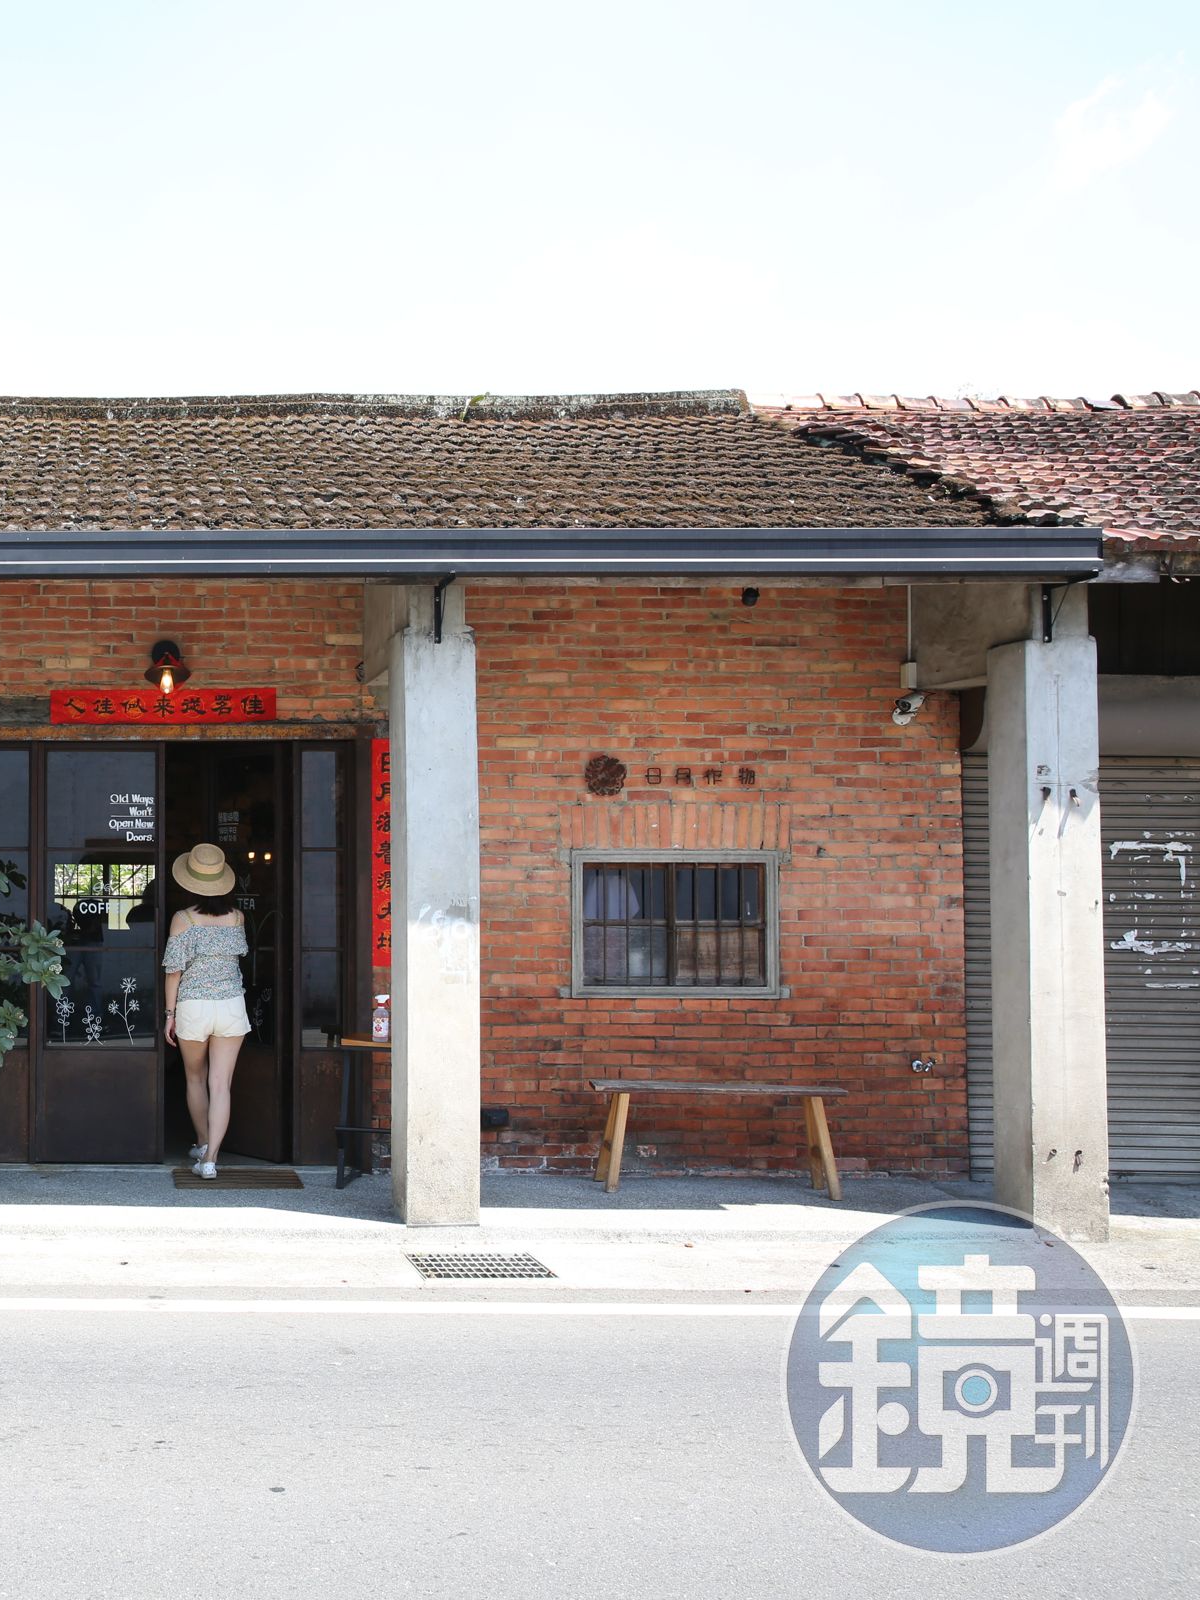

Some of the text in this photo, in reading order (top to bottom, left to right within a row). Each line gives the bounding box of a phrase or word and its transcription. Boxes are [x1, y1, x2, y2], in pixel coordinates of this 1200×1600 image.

[645, 767, 755, 785] 日月作物
[110, 793, 154, 806] Old Ways
[129, 806, 153, 816] Won't
[109, 818, 154, 831] Open New
[126, 831, 155, 842] Doors.
[79, 901, 128, 914] COFF
[237, 898, 255, 910] TEA
